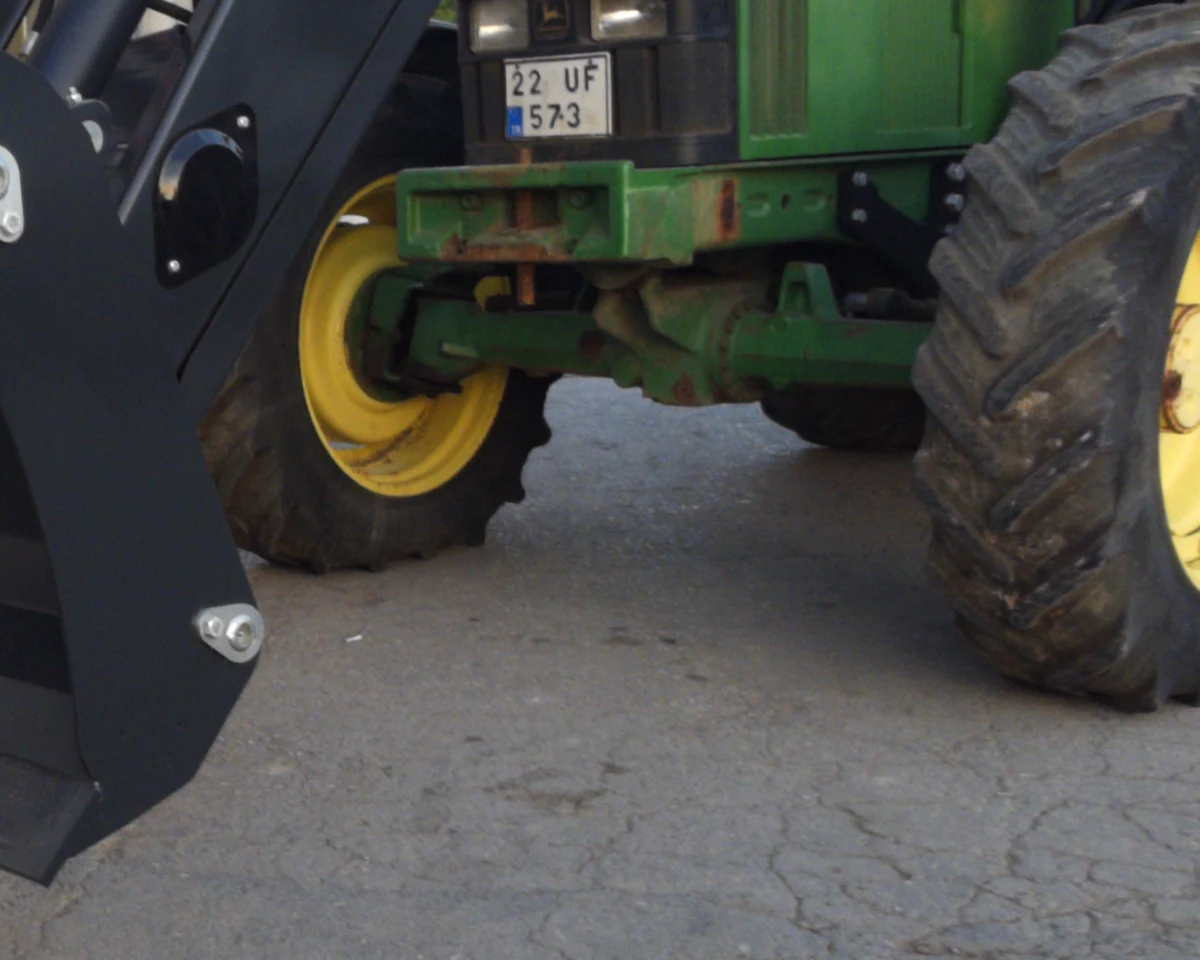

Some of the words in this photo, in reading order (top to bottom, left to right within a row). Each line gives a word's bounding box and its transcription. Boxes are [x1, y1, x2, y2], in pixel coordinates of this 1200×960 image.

[511, 68, 542, 97] 22
[564, 64, 599, 93] UF
[528, 102, 581, 130] 573
